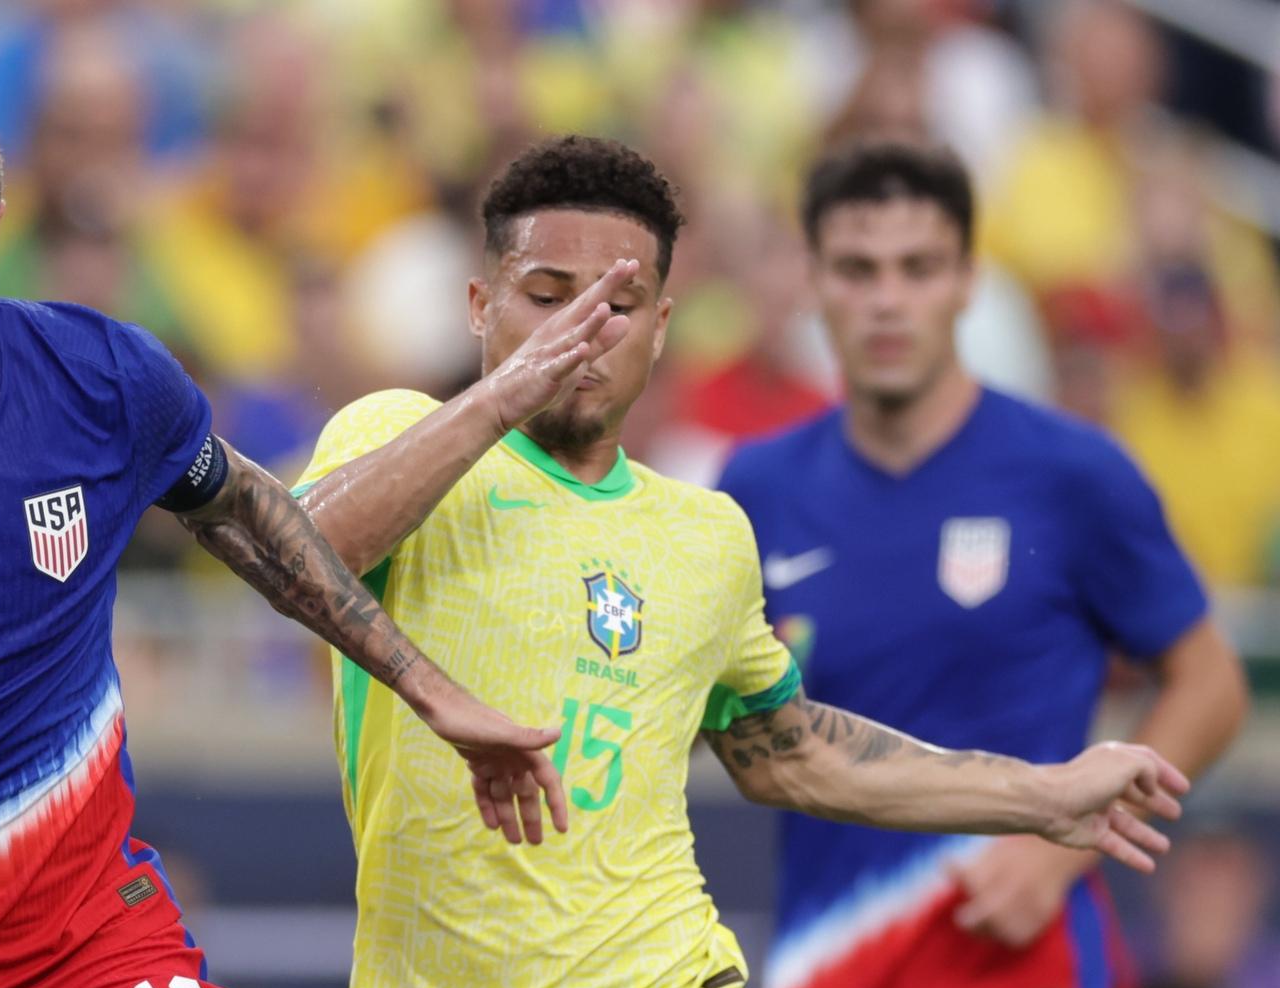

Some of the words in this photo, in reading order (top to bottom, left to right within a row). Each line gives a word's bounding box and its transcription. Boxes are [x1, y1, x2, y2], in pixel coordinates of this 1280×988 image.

[28, 491, 81, 531] USA
[604, 603, 625, 617] CBF
[575, 657, 640, 689] BRASIL
[551, 697, 633, 812] 15
